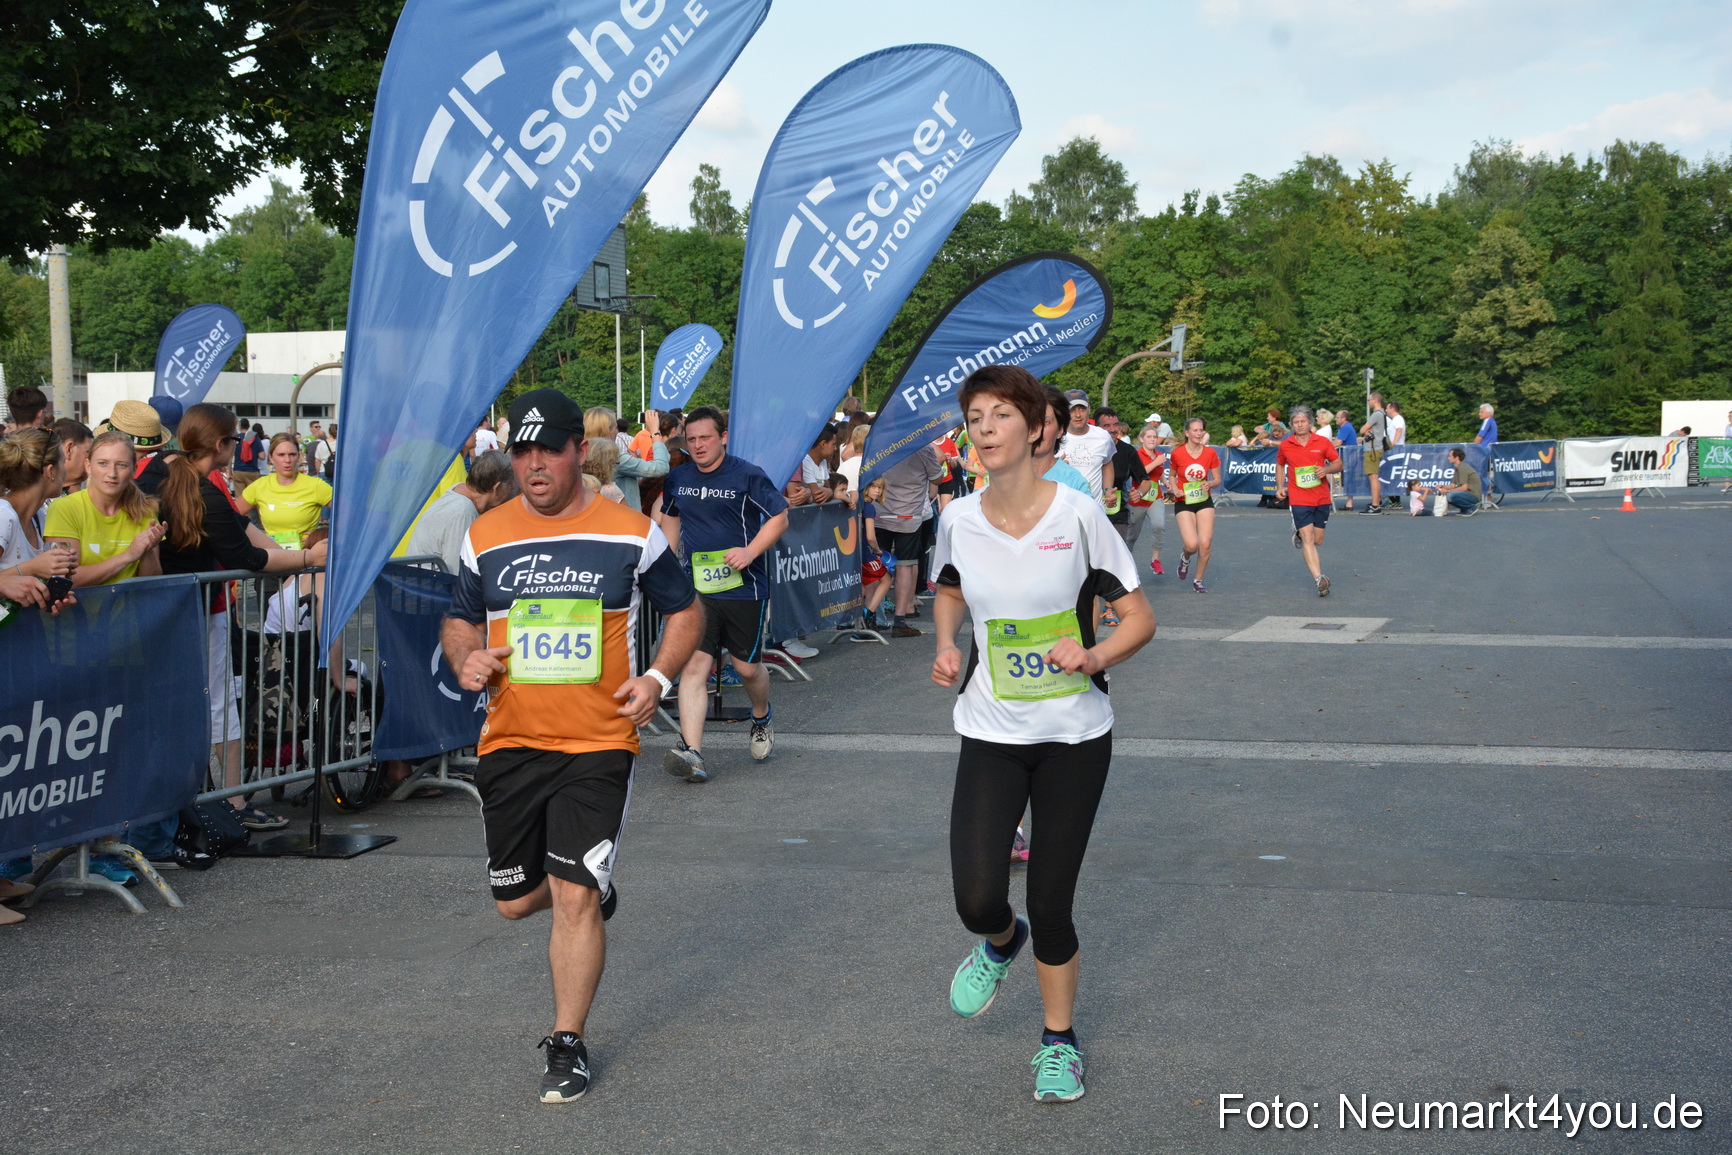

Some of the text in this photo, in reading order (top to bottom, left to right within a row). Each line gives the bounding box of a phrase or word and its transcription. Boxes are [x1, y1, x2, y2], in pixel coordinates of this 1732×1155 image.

[541, 0, 710, 228] AUTOMOBILE
[809, 90, 960, 294] Fischer
[862, 128, 976, 291] AUTOMOBILE
[1033, 336, 1056, 353] und
[1056, 313, 1098, 343] Medien
[176, 319, 225, 387] Fischer
[194, 332, 231, 386] AUTOMOBILE
[668, 336, 707, 390] Fischer
[682, 346, 712, 389] AUTOMOBILE
[902, 322, 1048, 411] Frischmann
[1187, 469, 1203, 479] 48
[1390, 465, 1455, 480] Fische
[1494, 457, 1542, 472] Frischmann
[1611, 450, 1658, 472] swn
[678, 486, 736, 499] EURO POLES
[775, 545, 839, 584] Frischmann
[1044, 542, 1074, 550] partner
[513, 566, 604, 586] Fischer
[521, 585, 597, 594] AUTOMOBILE
[703, 566, 732, 582] 349
[517, 632, 592, 660] 1645
[0, 700, 123, 777] cher
[0, 769, 106, 819] MOBILE
[490, 873, 526, 887] STIEGLER
